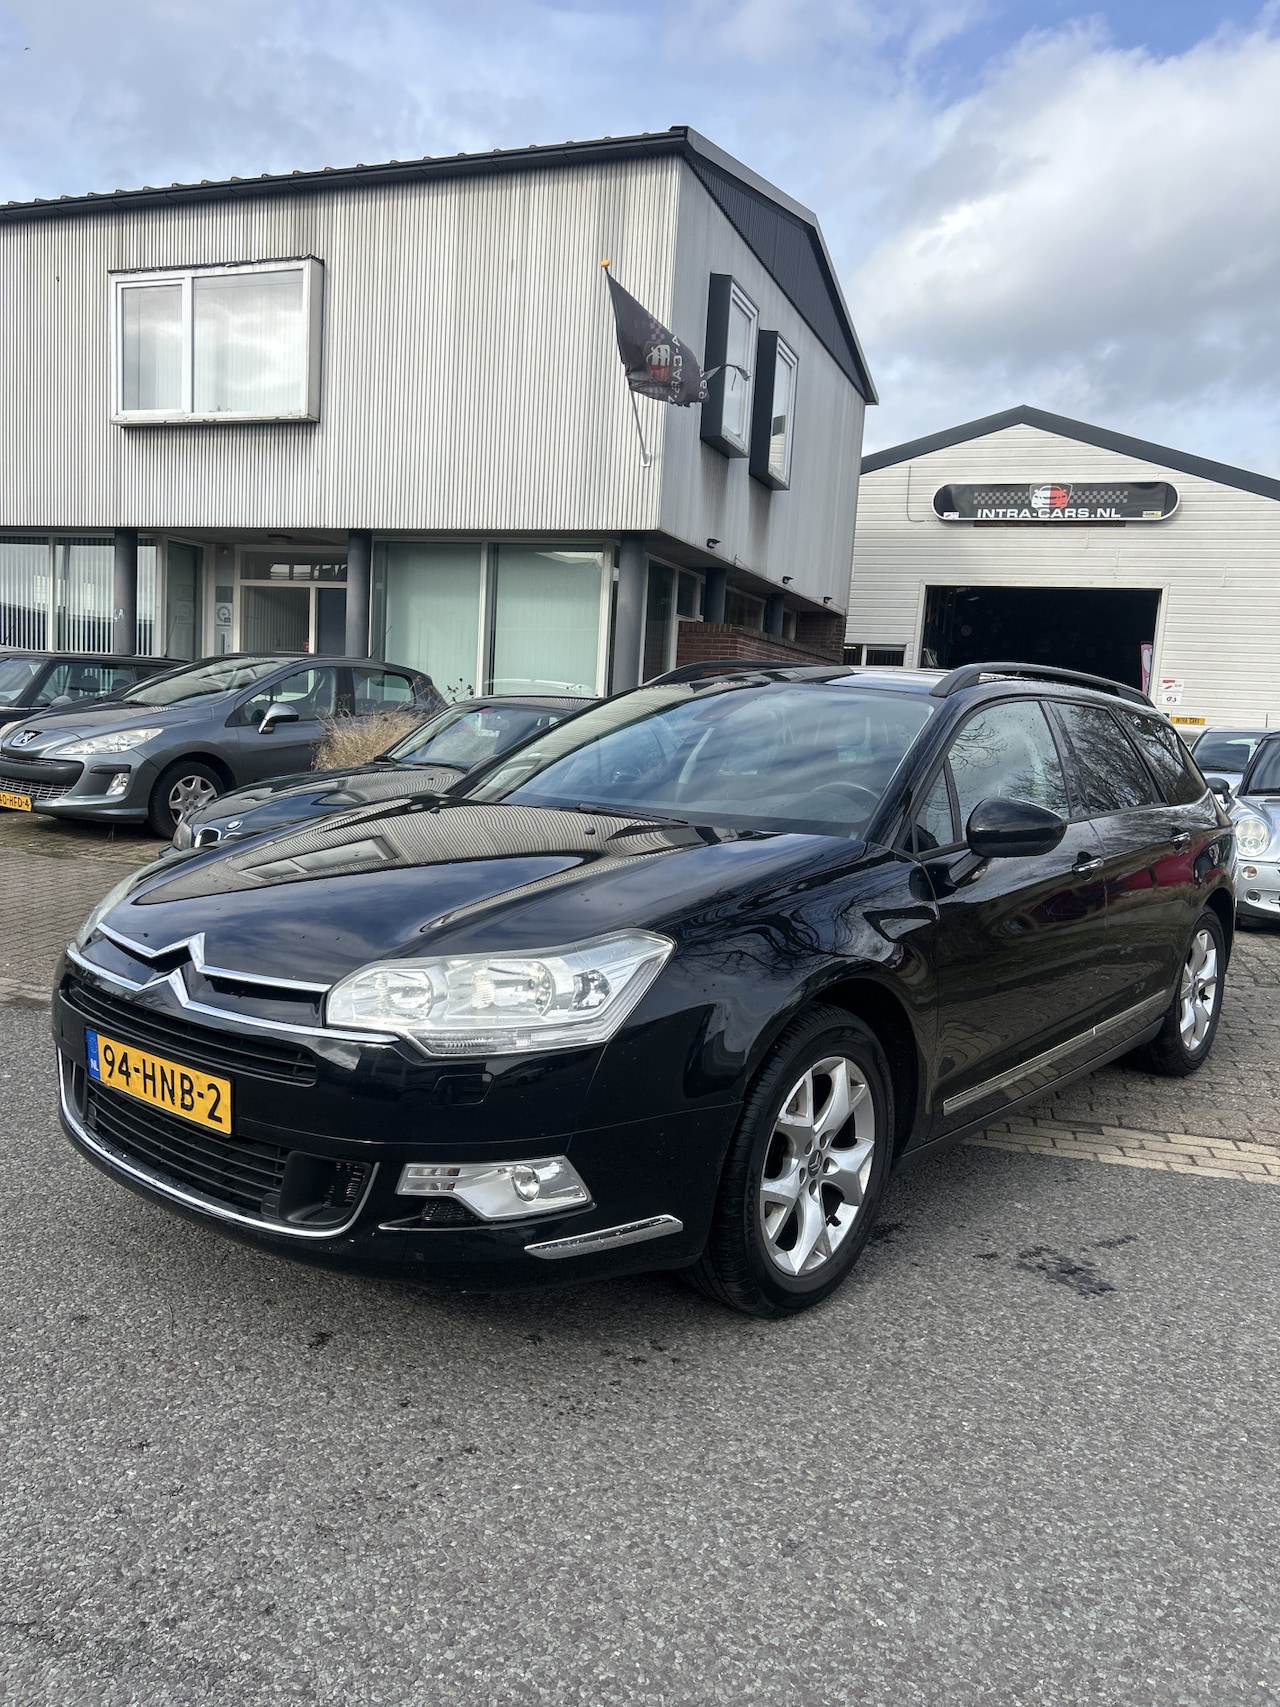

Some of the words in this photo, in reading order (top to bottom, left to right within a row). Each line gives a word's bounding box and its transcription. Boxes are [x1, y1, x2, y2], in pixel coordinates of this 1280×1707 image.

[977, 508, 1121, 518] INTRA-CARS.NL
[90, 1058, 99, 1072] NL
[103, 1043, 223, 1124] 94-HNB-2
